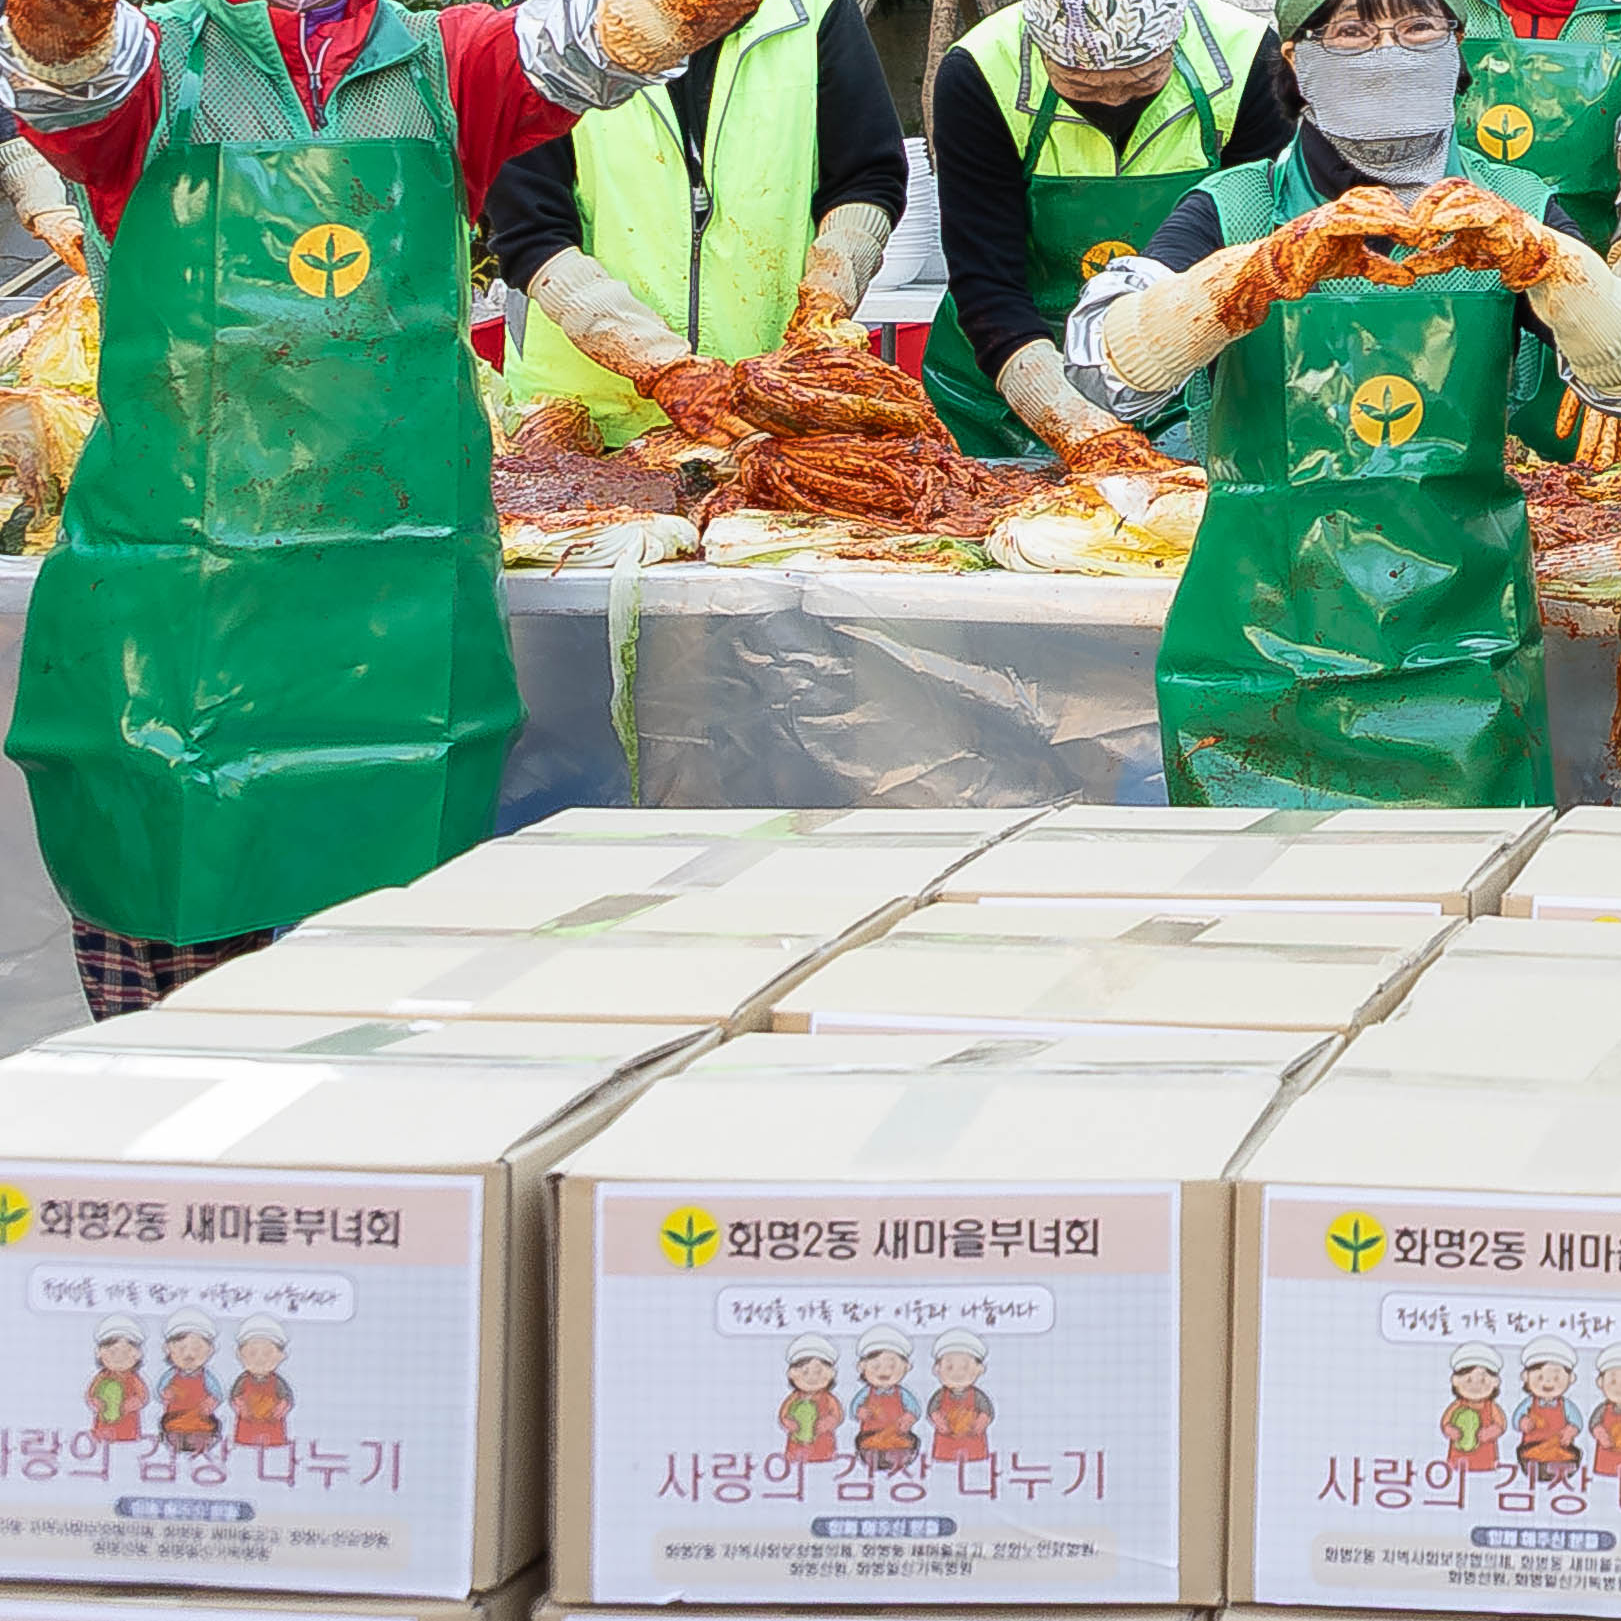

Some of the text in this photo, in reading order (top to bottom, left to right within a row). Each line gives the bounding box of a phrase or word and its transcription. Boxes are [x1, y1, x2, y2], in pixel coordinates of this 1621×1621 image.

[39, 1199, 402, 1247] 화명2동 새마을부녀회
[728, 1219, 1099, 1260] 화명2동 새마을부녀회
[1393, 1227, 1526, 1268] 화명2동
[658, 1450, 1105, 1503] 사랑의 김장 나누기
[1318, 1455, 1465, 1510] 사랑의
[1496, 1461, 1593, 1515] 김장
